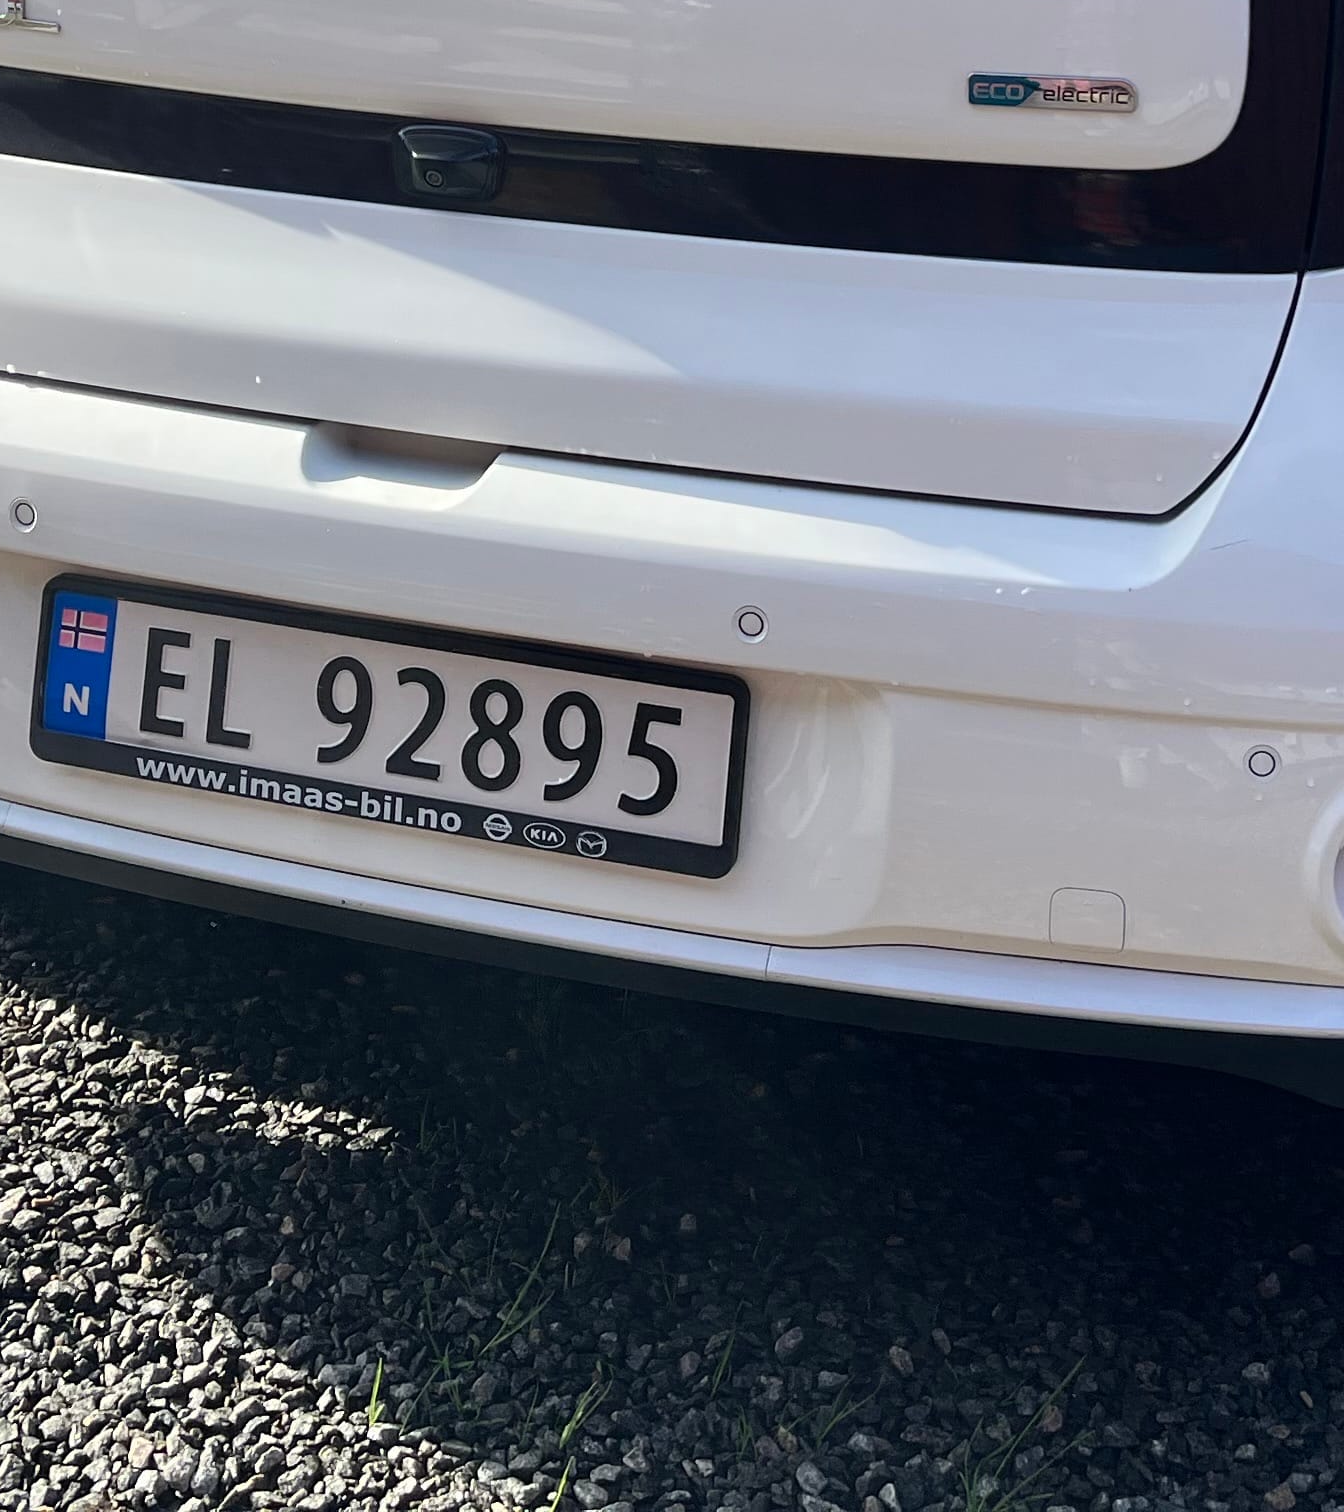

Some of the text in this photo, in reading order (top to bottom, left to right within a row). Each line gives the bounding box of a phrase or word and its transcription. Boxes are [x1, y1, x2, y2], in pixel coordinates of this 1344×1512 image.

[973, 82, 1129, 105] ECO electric
[62, 683, 89, 716] N
[140, 627, 682, 816] EL 92895
[136, 753, 462, 834] www.imaas-bil.no
[530, 828, 558, 843] KIA
